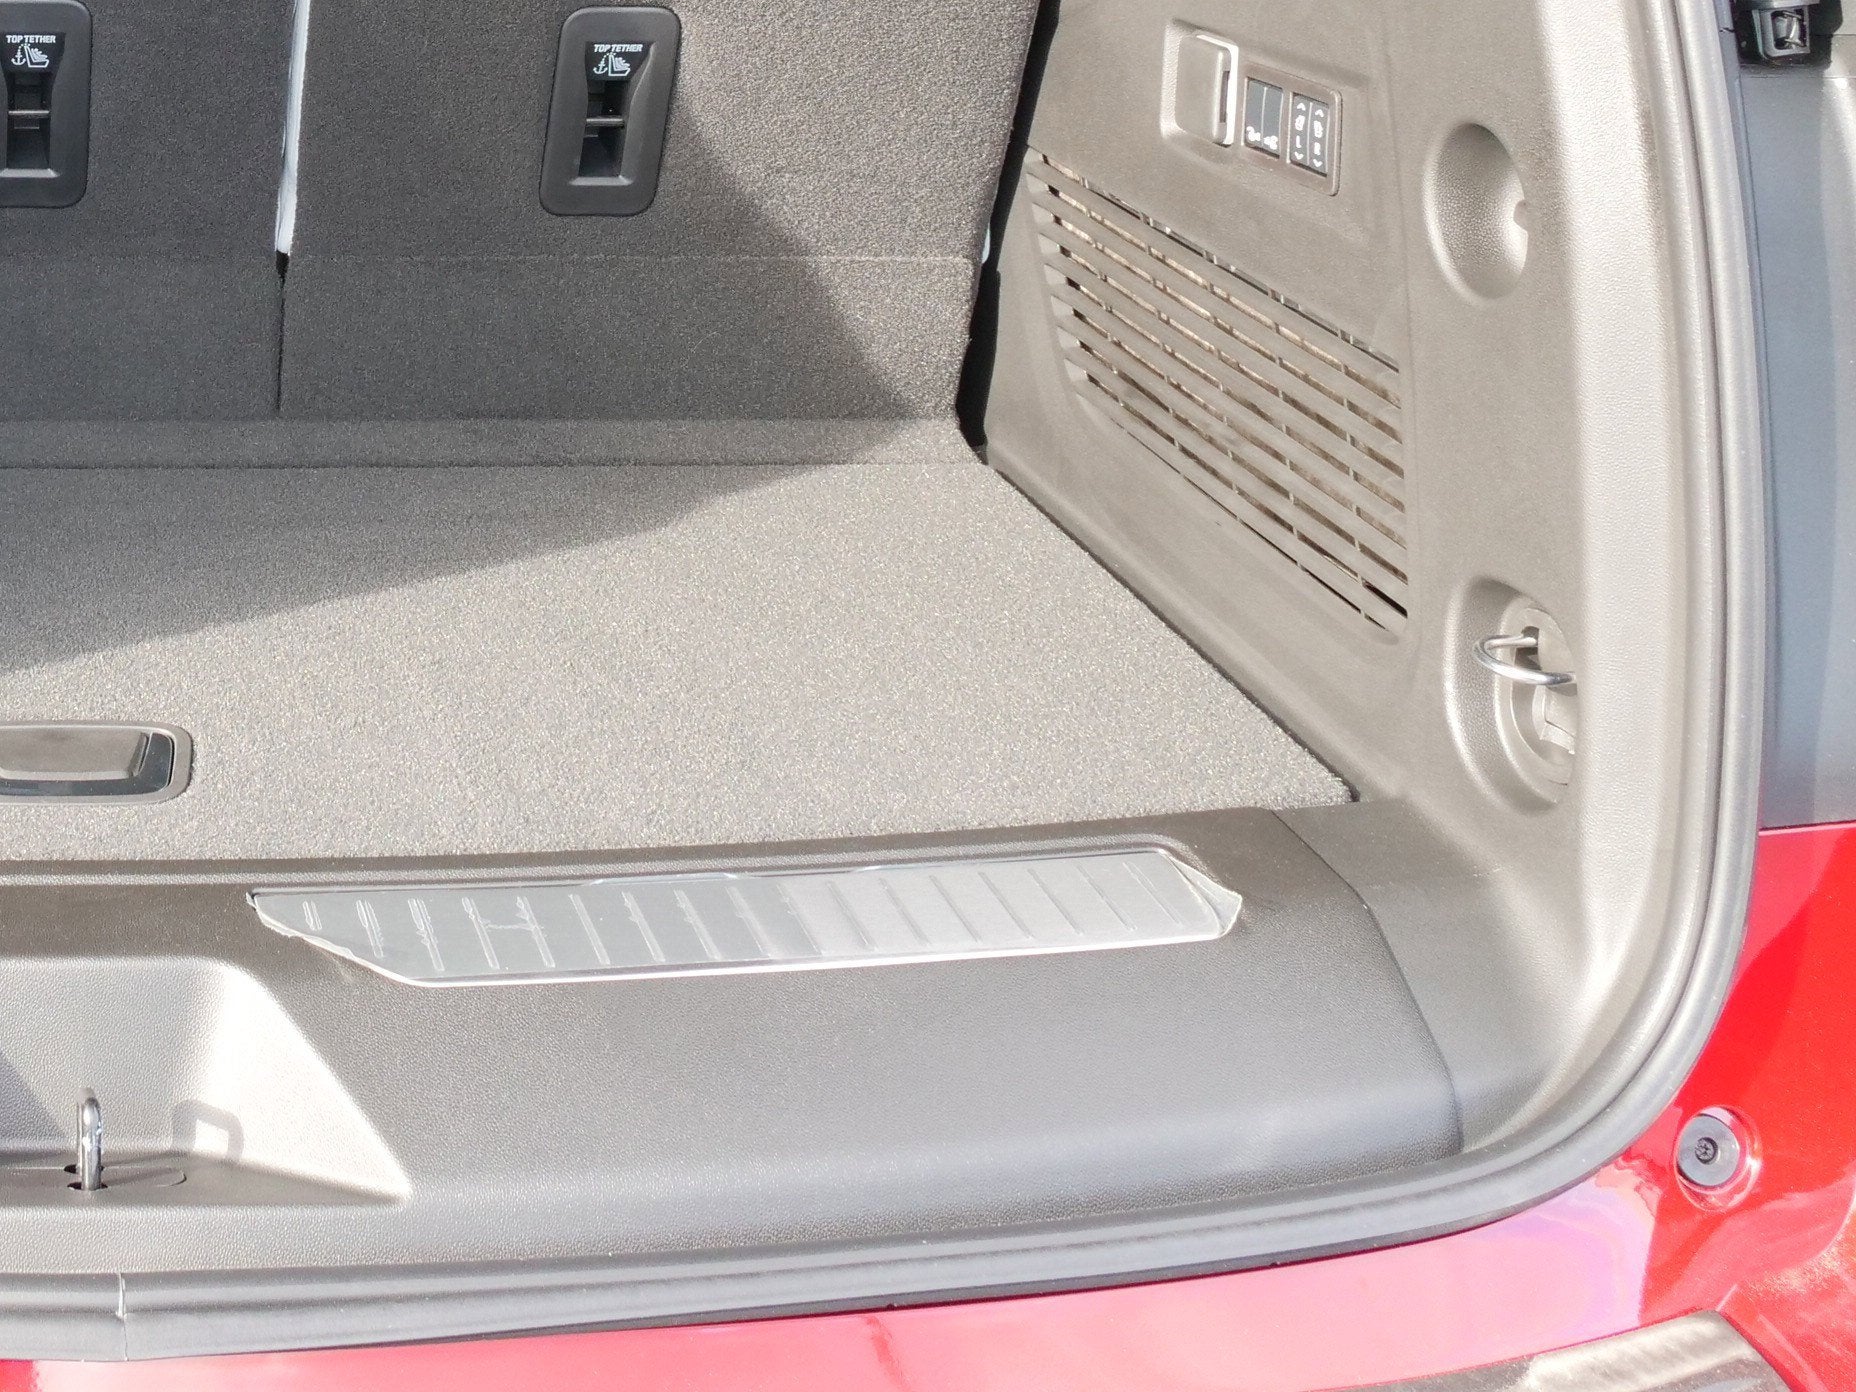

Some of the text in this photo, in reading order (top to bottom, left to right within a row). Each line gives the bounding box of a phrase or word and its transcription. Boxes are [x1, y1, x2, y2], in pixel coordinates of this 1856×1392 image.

[5, 34, 56, 43] TOP TETHER
[594, 43, 643, 52] TOP TETHER
[1295, 135, 1302, 149] L
